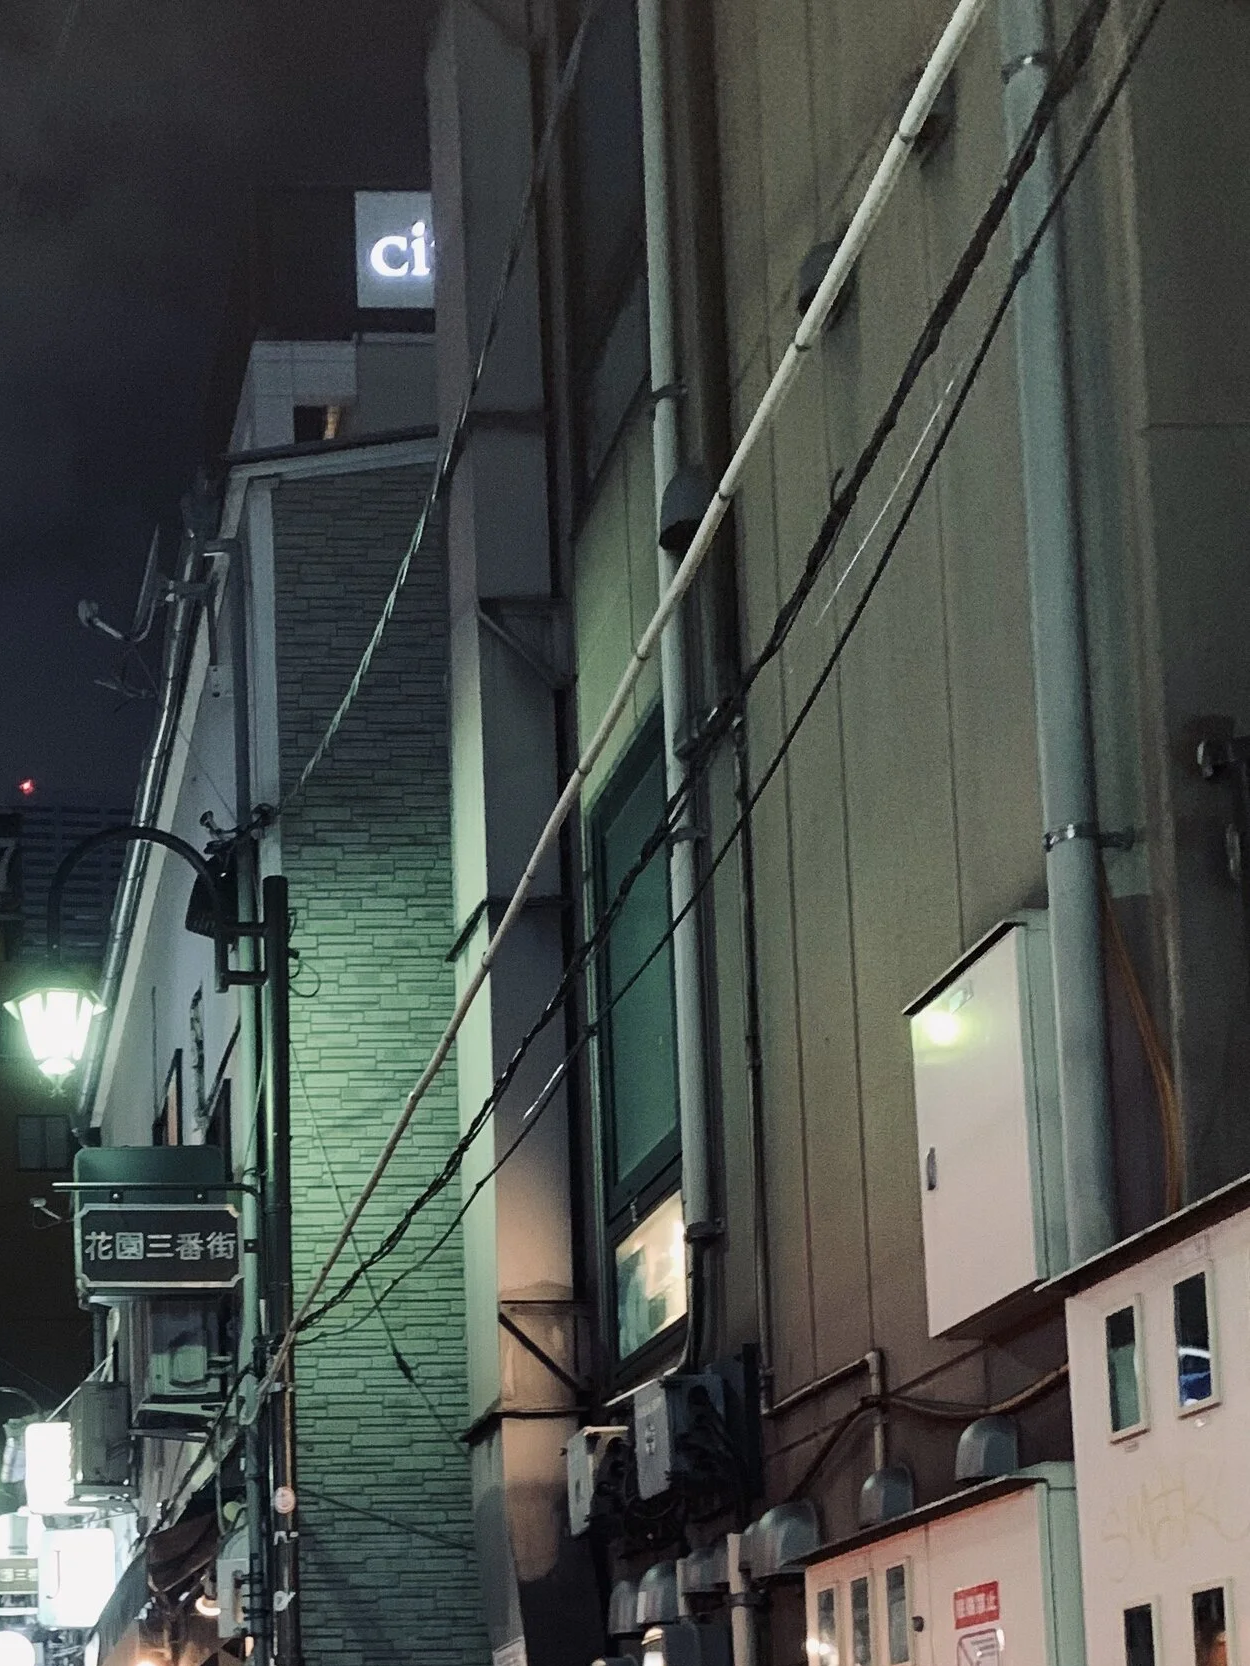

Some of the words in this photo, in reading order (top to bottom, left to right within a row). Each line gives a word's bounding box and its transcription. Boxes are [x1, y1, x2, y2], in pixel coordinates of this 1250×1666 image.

[370, 221, 435, 277] ci
[85, 1231, 236, 1261] 花園三番街
